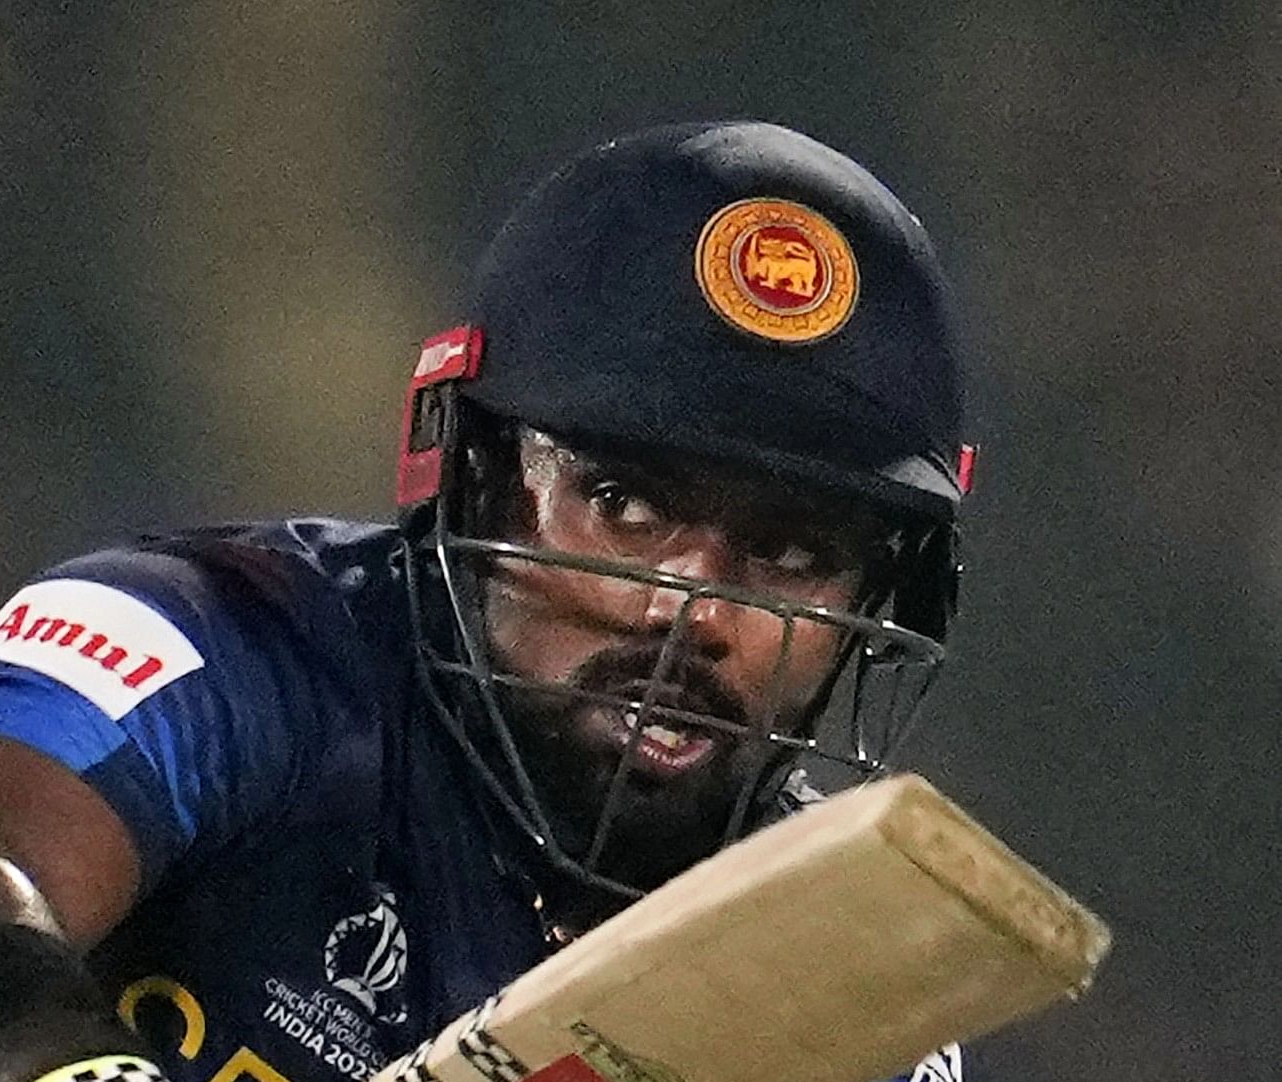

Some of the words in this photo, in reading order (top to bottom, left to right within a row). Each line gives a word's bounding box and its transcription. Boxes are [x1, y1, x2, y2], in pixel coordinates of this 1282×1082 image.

[263, 1001, 325, 1056] INDIA
[265, 978, 327, 1025] CRICKET
[325, 1015, 372, 1058] WORLD
